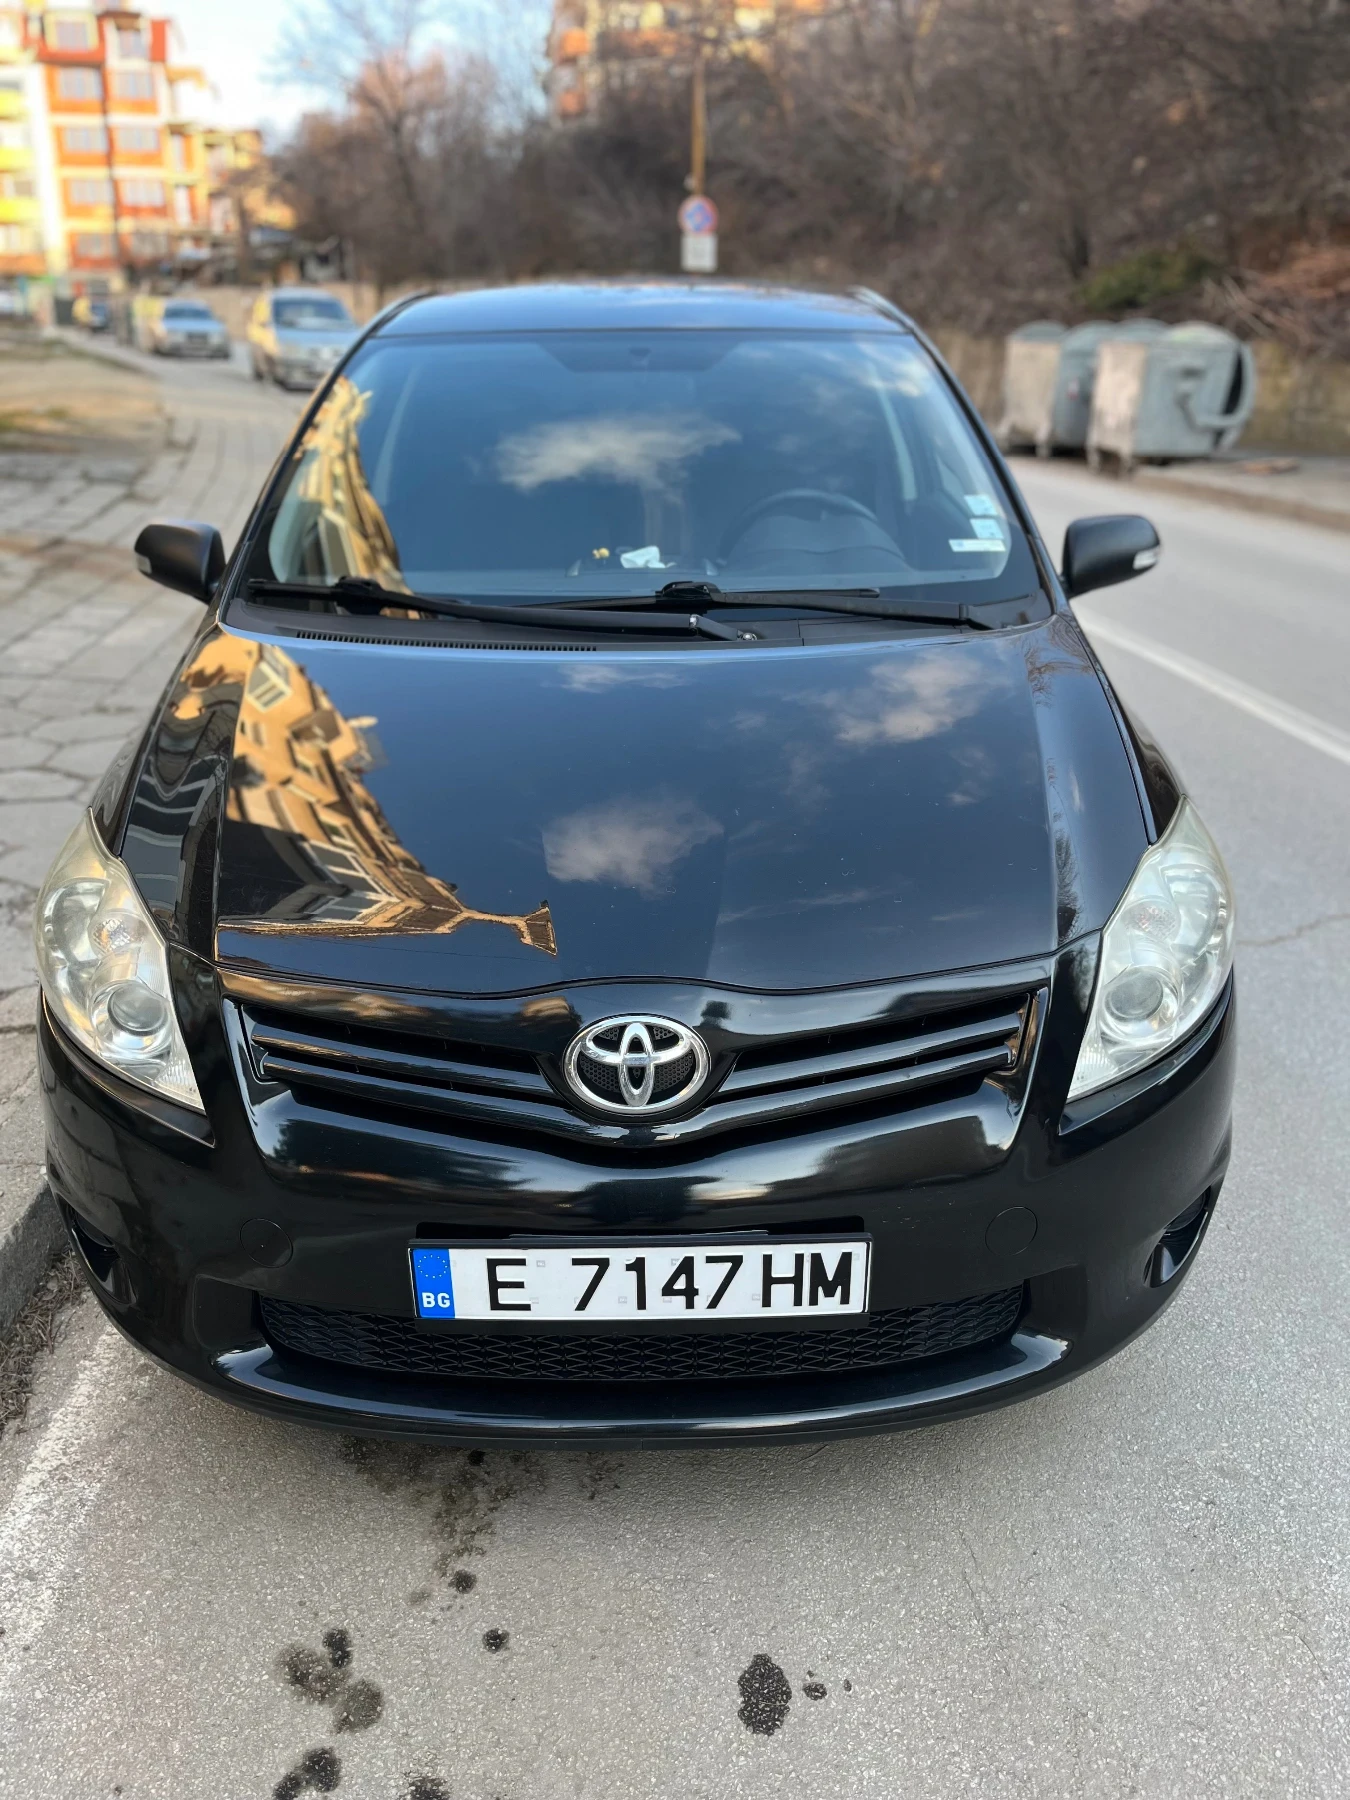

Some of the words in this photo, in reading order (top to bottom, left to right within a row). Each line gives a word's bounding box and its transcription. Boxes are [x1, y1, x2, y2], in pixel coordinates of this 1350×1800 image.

[422, 1291, 451, 1308] BG
[485, 1257, 532, 1311] E
[570, 1254, 744, 1312] 7147
[761, 1251, 853, 1308] HM
